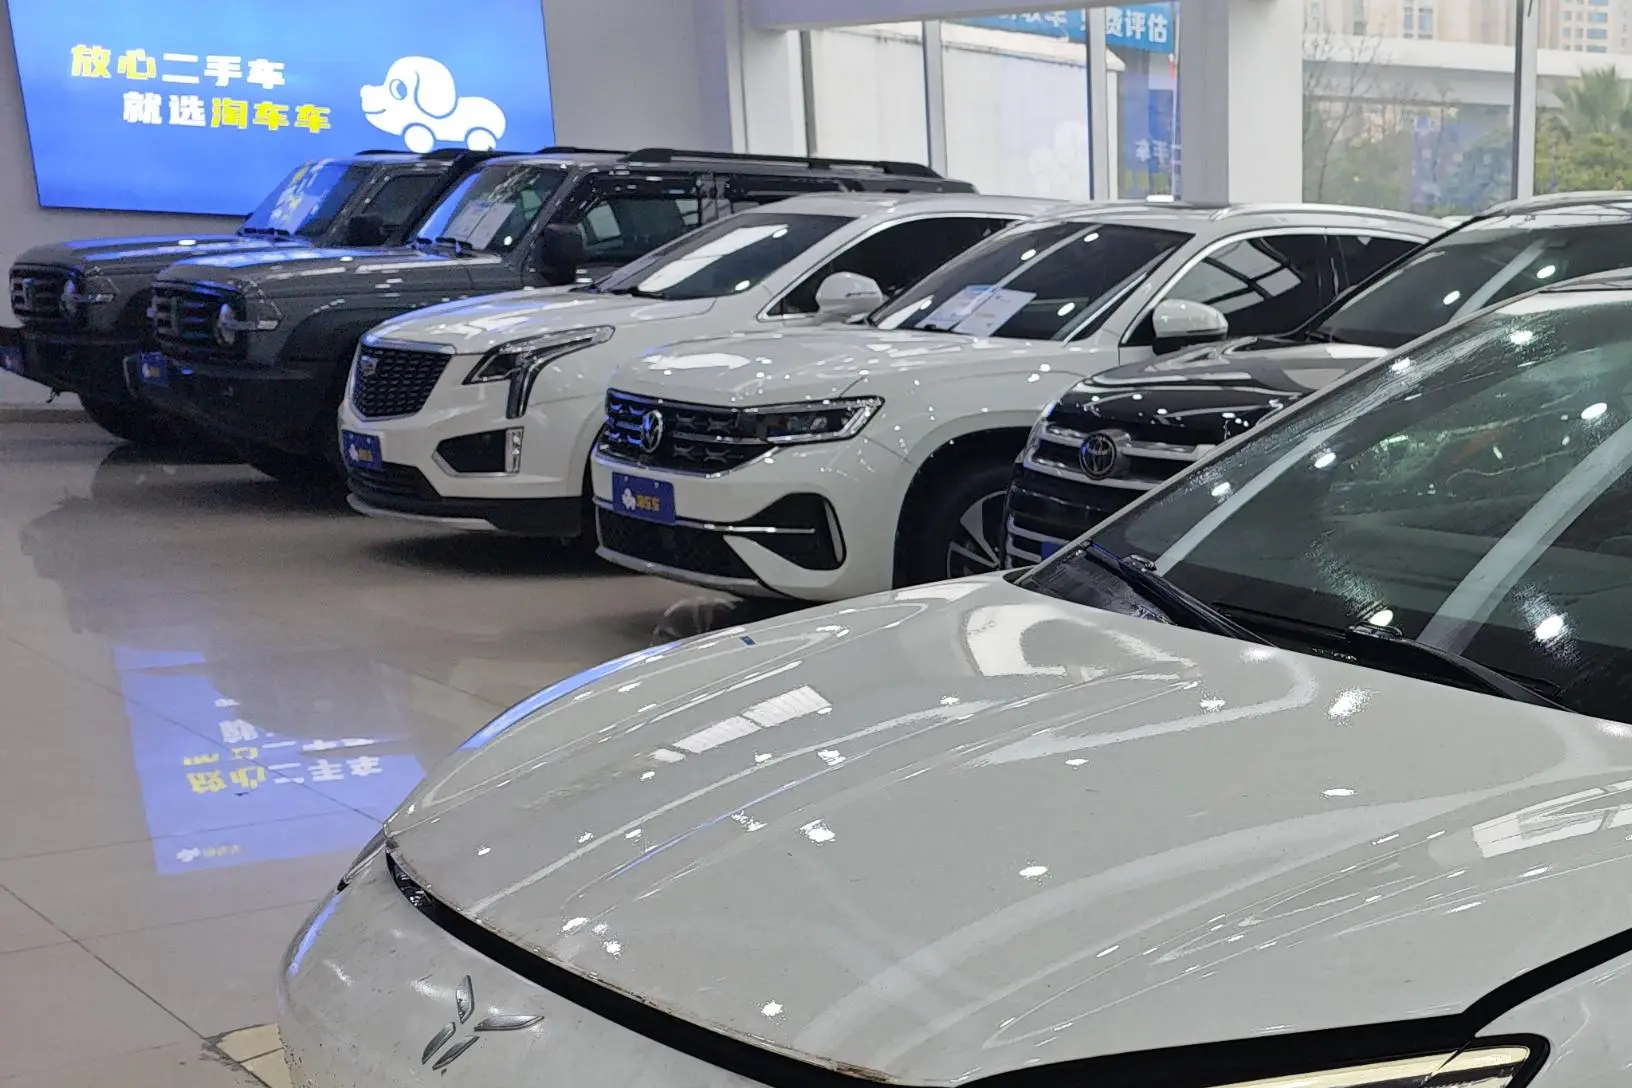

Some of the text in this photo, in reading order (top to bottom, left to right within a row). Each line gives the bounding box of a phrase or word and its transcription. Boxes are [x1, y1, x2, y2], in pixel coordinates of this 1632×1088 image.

[1080, 7, 1168, 43] 费评估
[71, 44, 286, 89] 放心二手车
[122, 90, 331, 133] 就选淘车车
